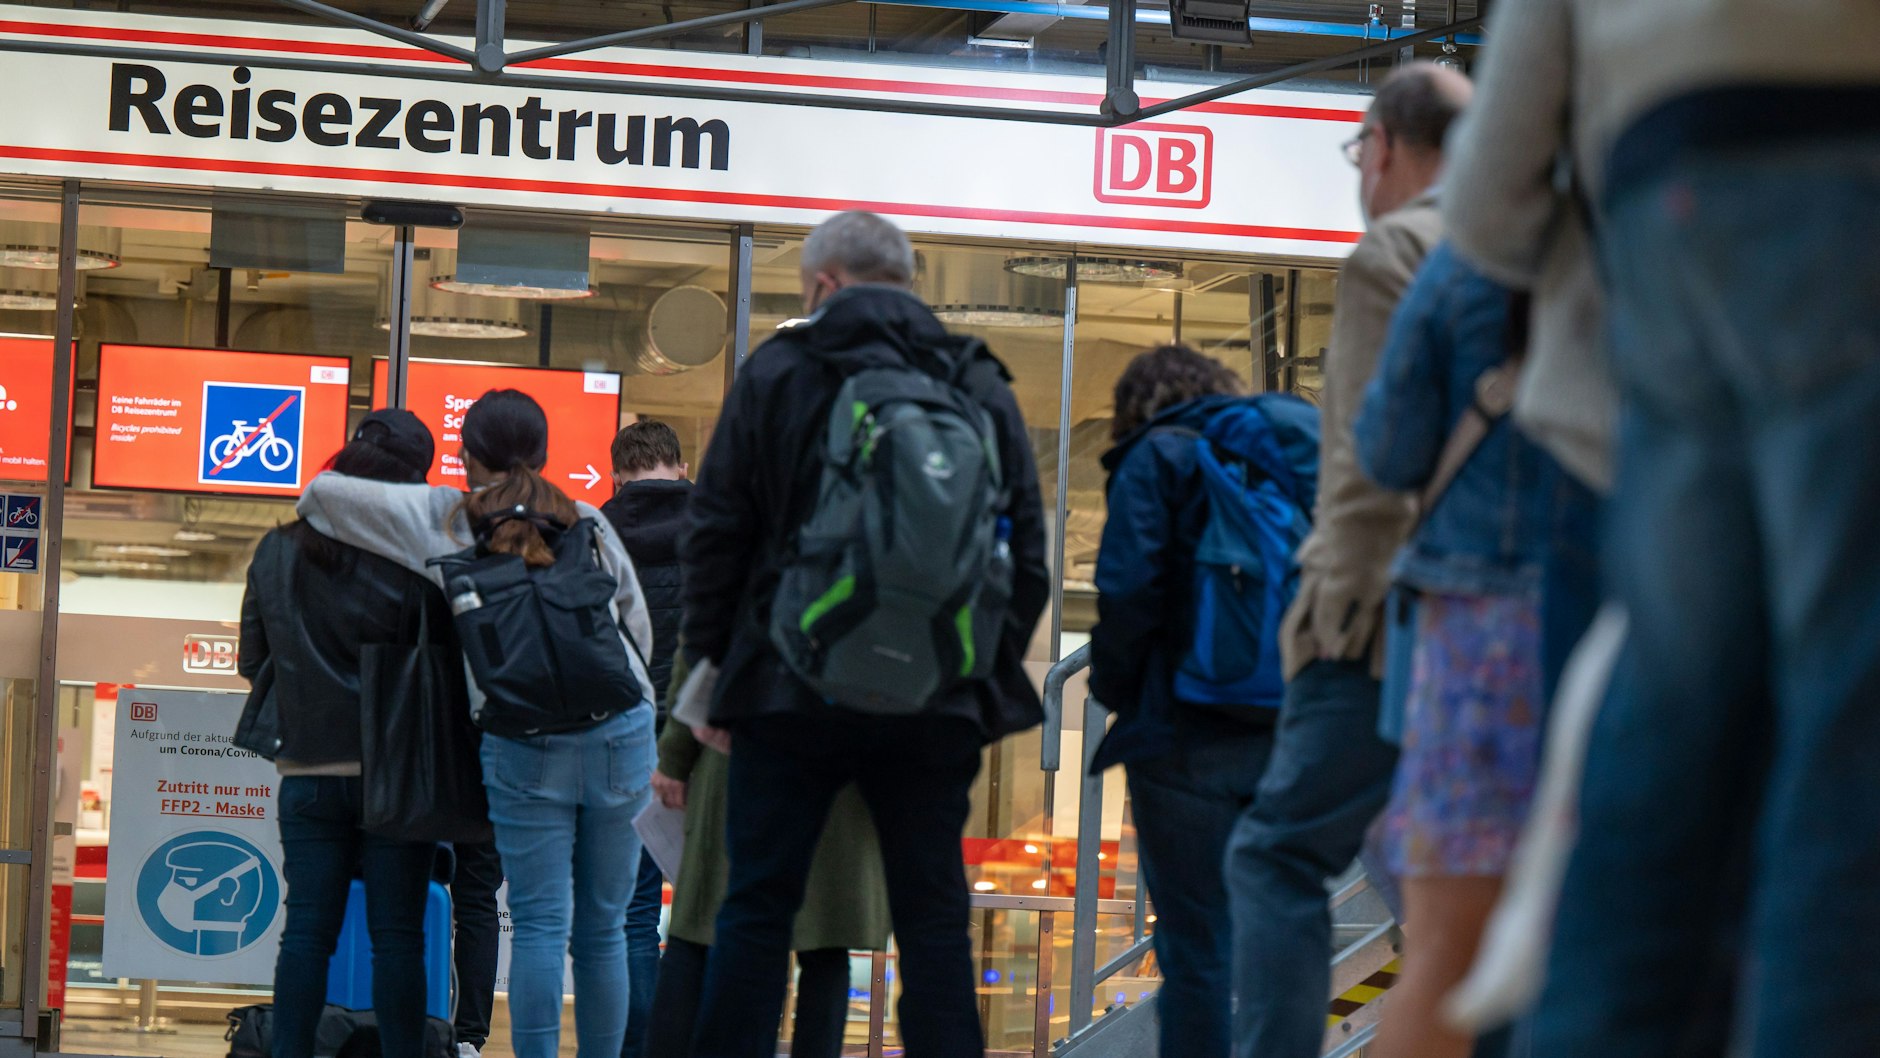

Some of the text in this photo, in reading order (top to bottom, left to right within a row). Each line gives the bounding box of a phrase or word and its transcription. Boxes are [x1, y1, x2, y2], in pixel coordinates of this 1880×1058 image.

[108, 62, 731, 171] Reisezentrum
[1109, 134, 1197, 194] DB
[112, 396, 182, 407] Keine Fahrräder im
[445, 394, 478, 412] Spe
[111, 406, 177, 417] DB Reisezentrum!
[111, 423, 182, 435] Bicycles prohibited
[190, 640, 233, 668] DB
[134, 705, 154, 719] DB
[130, 728, 234, 744] Aufgrund der aktue
[160, 746, 177, 754] um
[157, 779, 271, 798] Zutritt nur mit
[161, 799, 200, 813] FFP2
[215, 801, 265, 816] Maske
